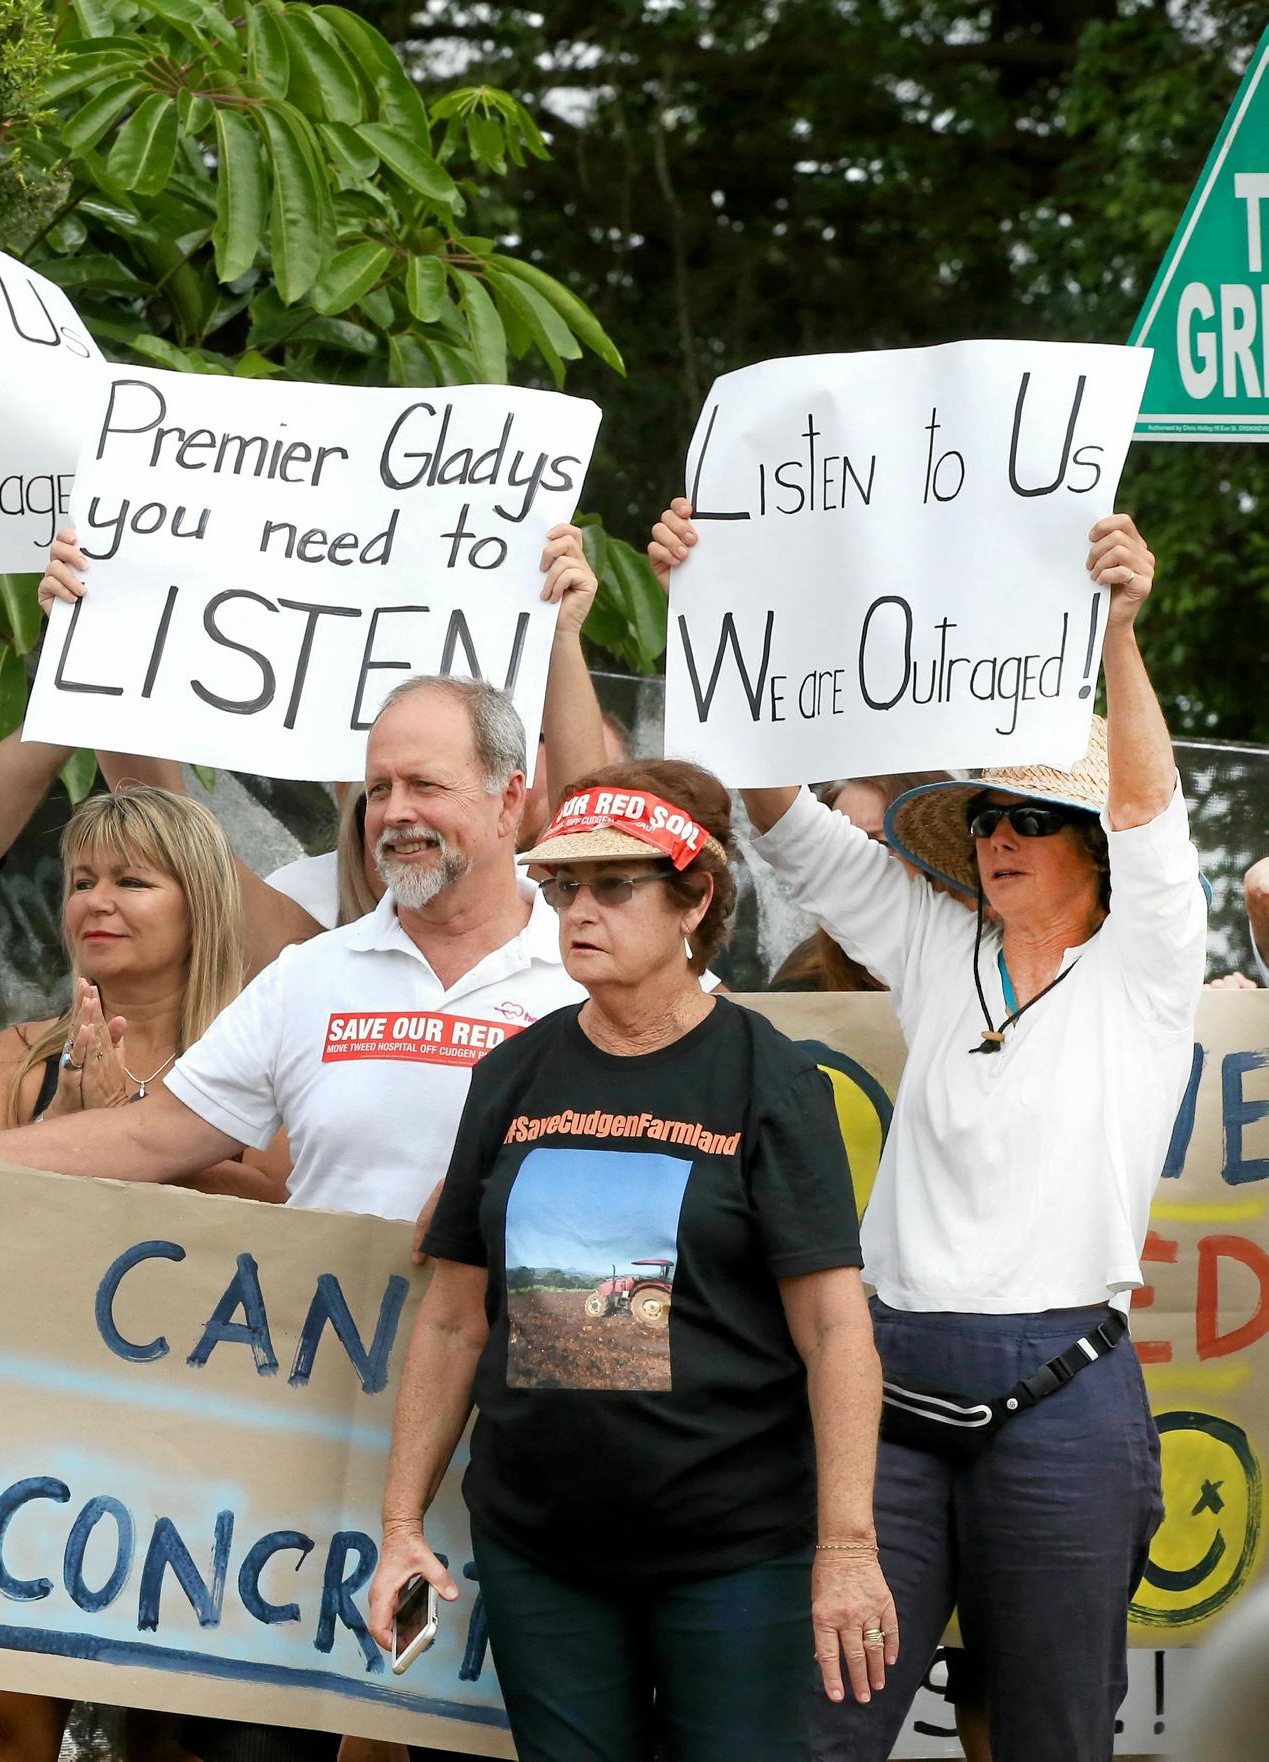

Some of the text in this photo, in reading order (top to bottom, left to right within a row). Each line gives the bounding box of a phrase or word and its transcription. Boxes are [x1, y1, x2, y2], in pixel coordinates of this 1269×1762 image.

[1234, 172, 1269, 272] T
[1176, 282, 1269, 400] GR
[96, 379, 582, 522] Premier Gladys
[924, 407, 965, 504] to
[79, 496, 508, 570] you need to
[54, 582, 531, 731] LISTEN
[594, 792, 645, 819] RED
[650, 806, 700, 851] SOIL
[326, 1043, 348, 1053] MOVE
[349, 1042, 376, 1052] TWEED
[378, 1042, 418, 1053] HOSPITAL
[420, 1043, 438, 1054] OFF
[439, 1046, 476, 1059] CUDGEN
[328, 1017, 505, 1049] SAVE OUR RED
[503, 1109, 743, 1156] #SaveCudgenFarmland
[95, 1239, 410, 1395] CAN
